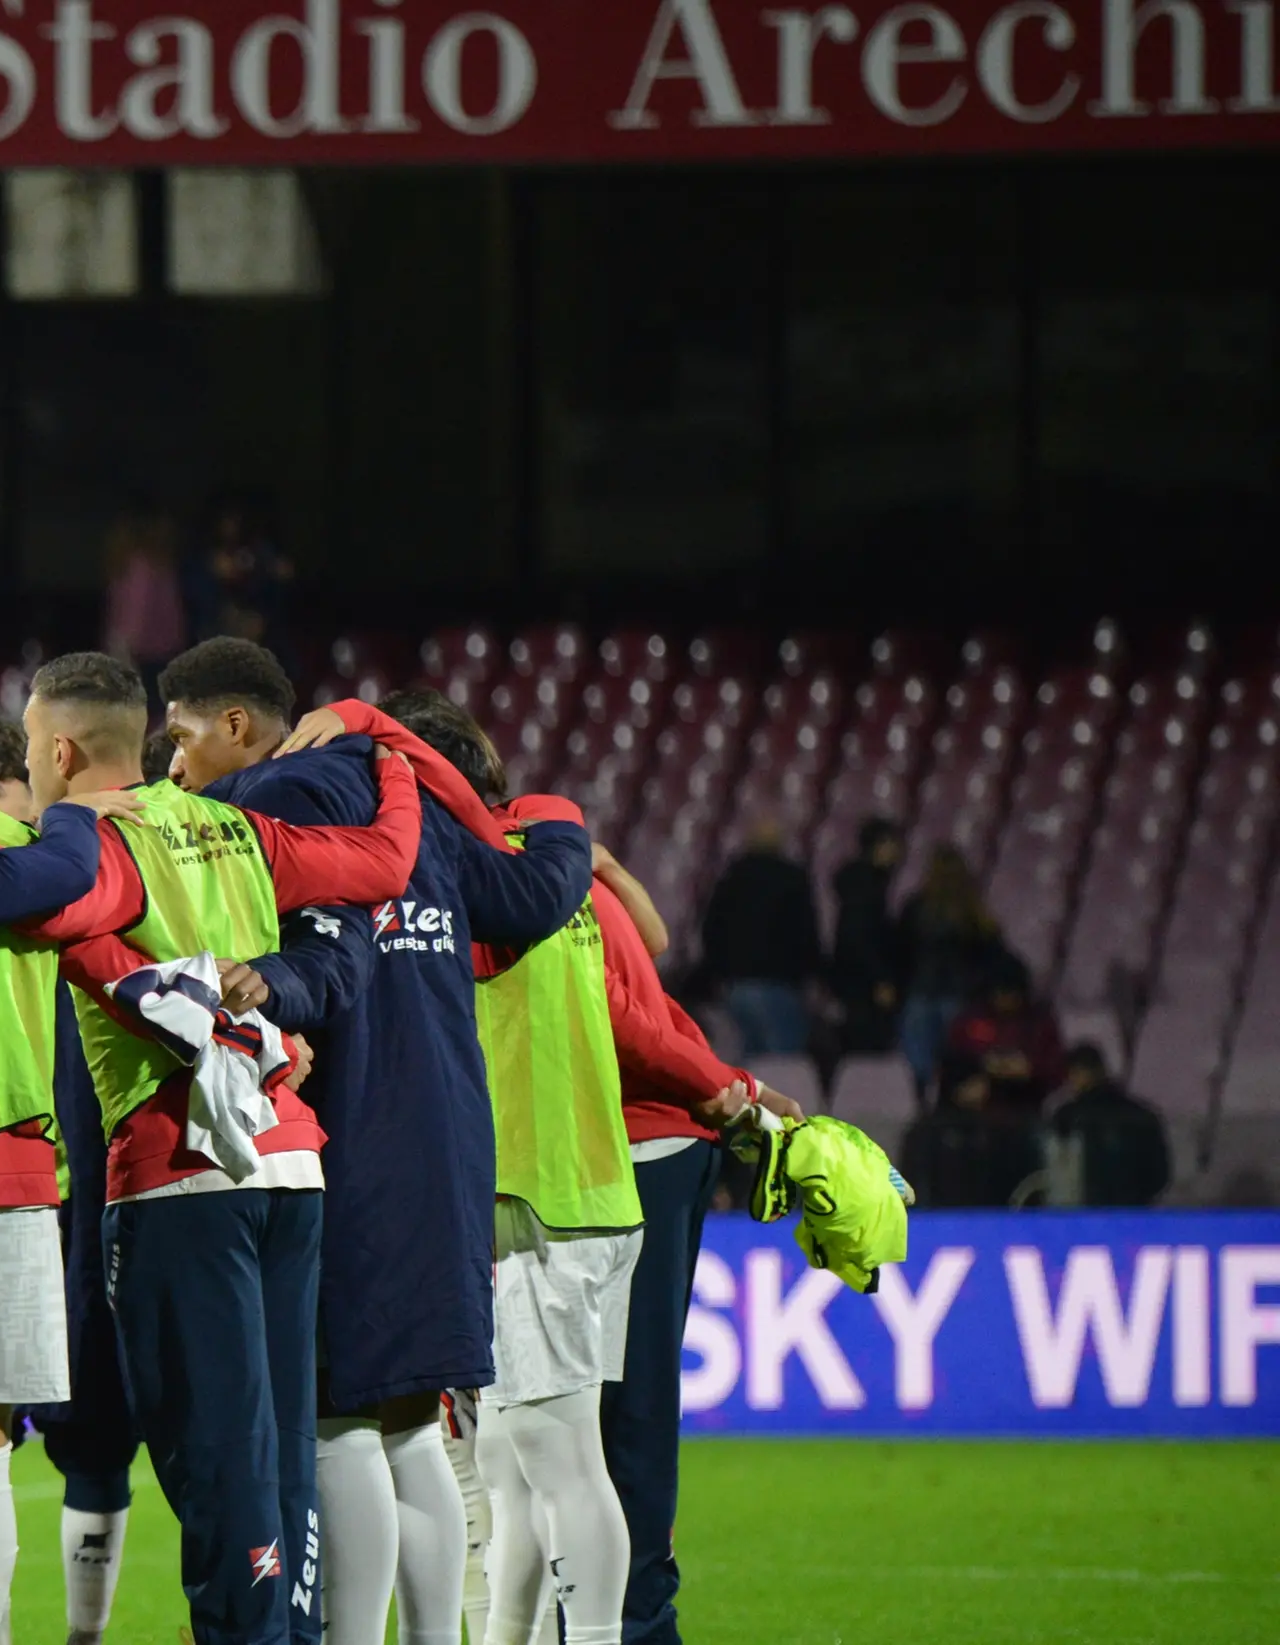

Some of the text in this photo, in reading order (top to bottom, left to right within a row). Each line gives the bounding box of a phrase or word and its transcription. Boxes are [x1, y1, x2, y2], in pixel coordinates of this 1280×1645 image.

[606, 0, 1280, 129] Arechi
[379, 937, 429, 953] veste
[107, 1243, 121, 1297] Zeus
[678, 1246, 976, 1411] SKY
[291, 1508, 320, 1617] Zeus
